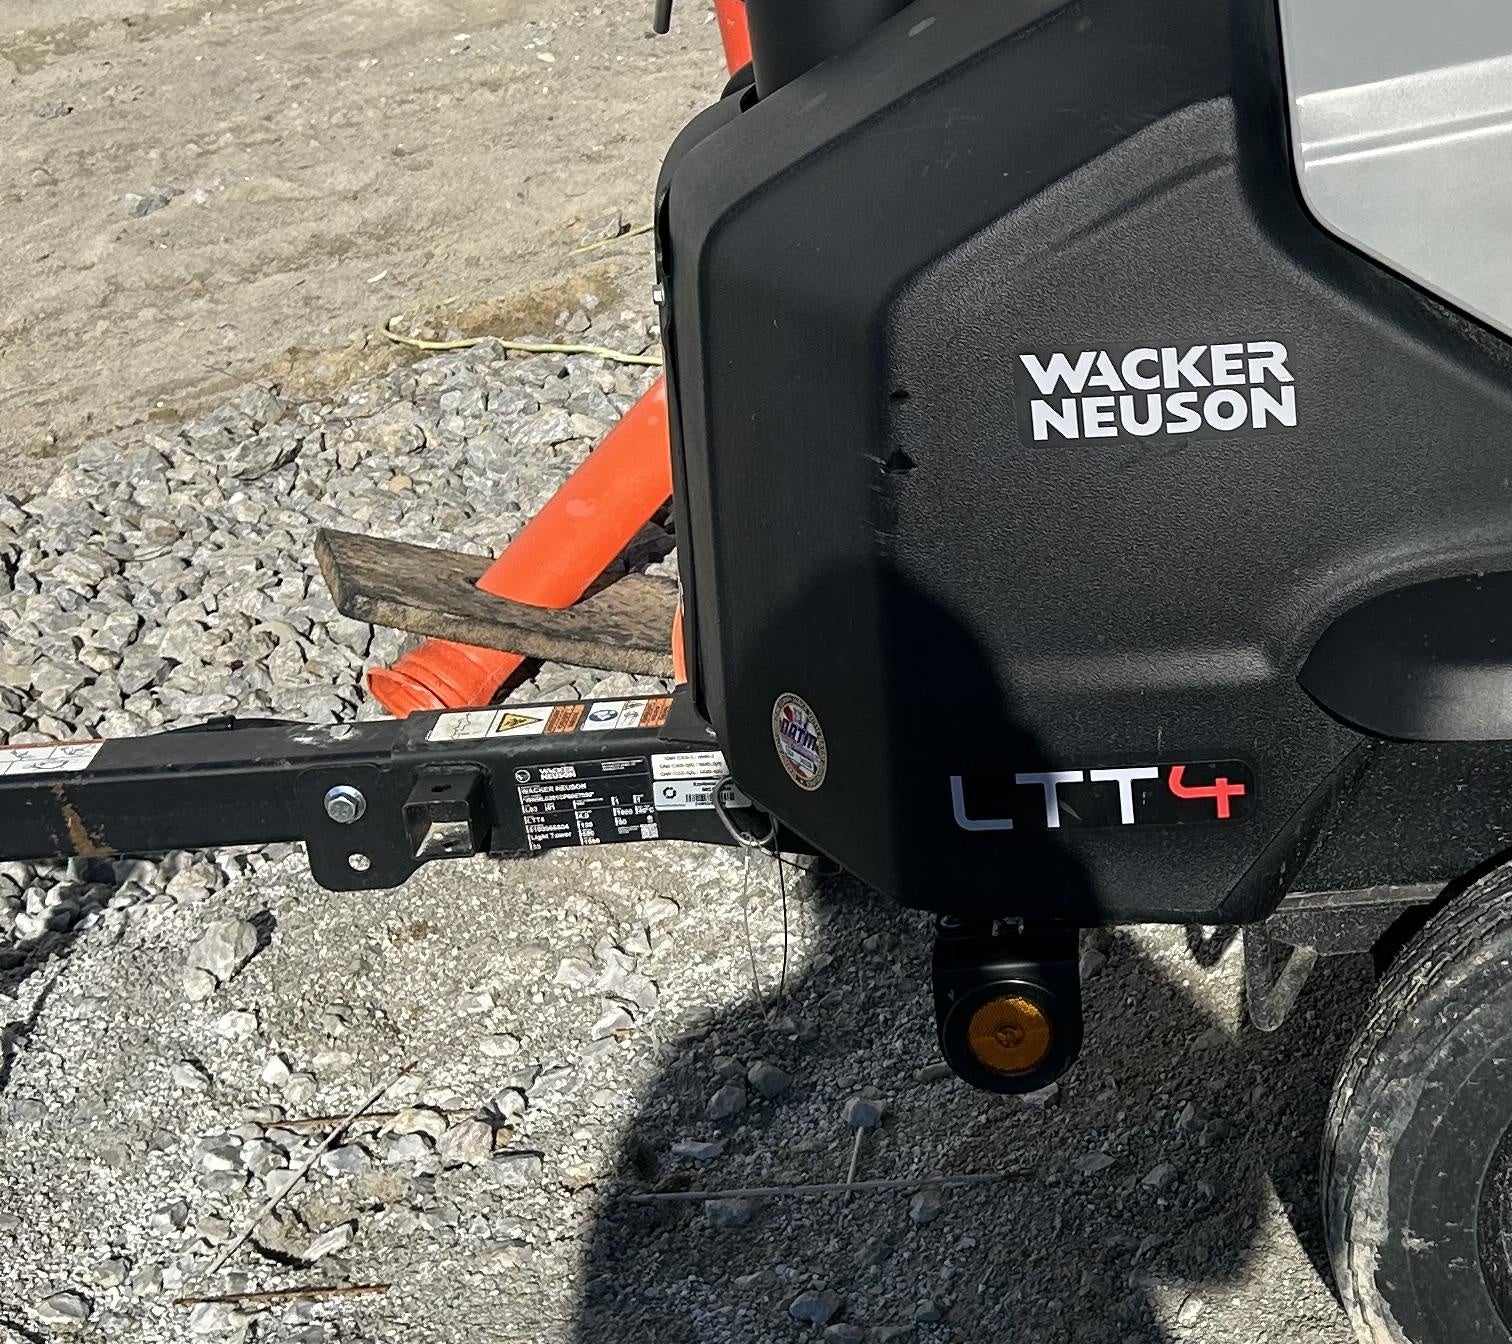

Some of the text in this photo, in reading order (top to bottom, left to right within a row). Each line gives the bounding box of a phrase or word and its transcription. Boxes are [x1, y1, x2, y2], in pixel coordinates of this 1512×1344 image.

[1018, 340, 1296, 395] WACKER
[1030, 385, 1298, 441] NEUSON
[949, 765, 1246, 832] LTT4
